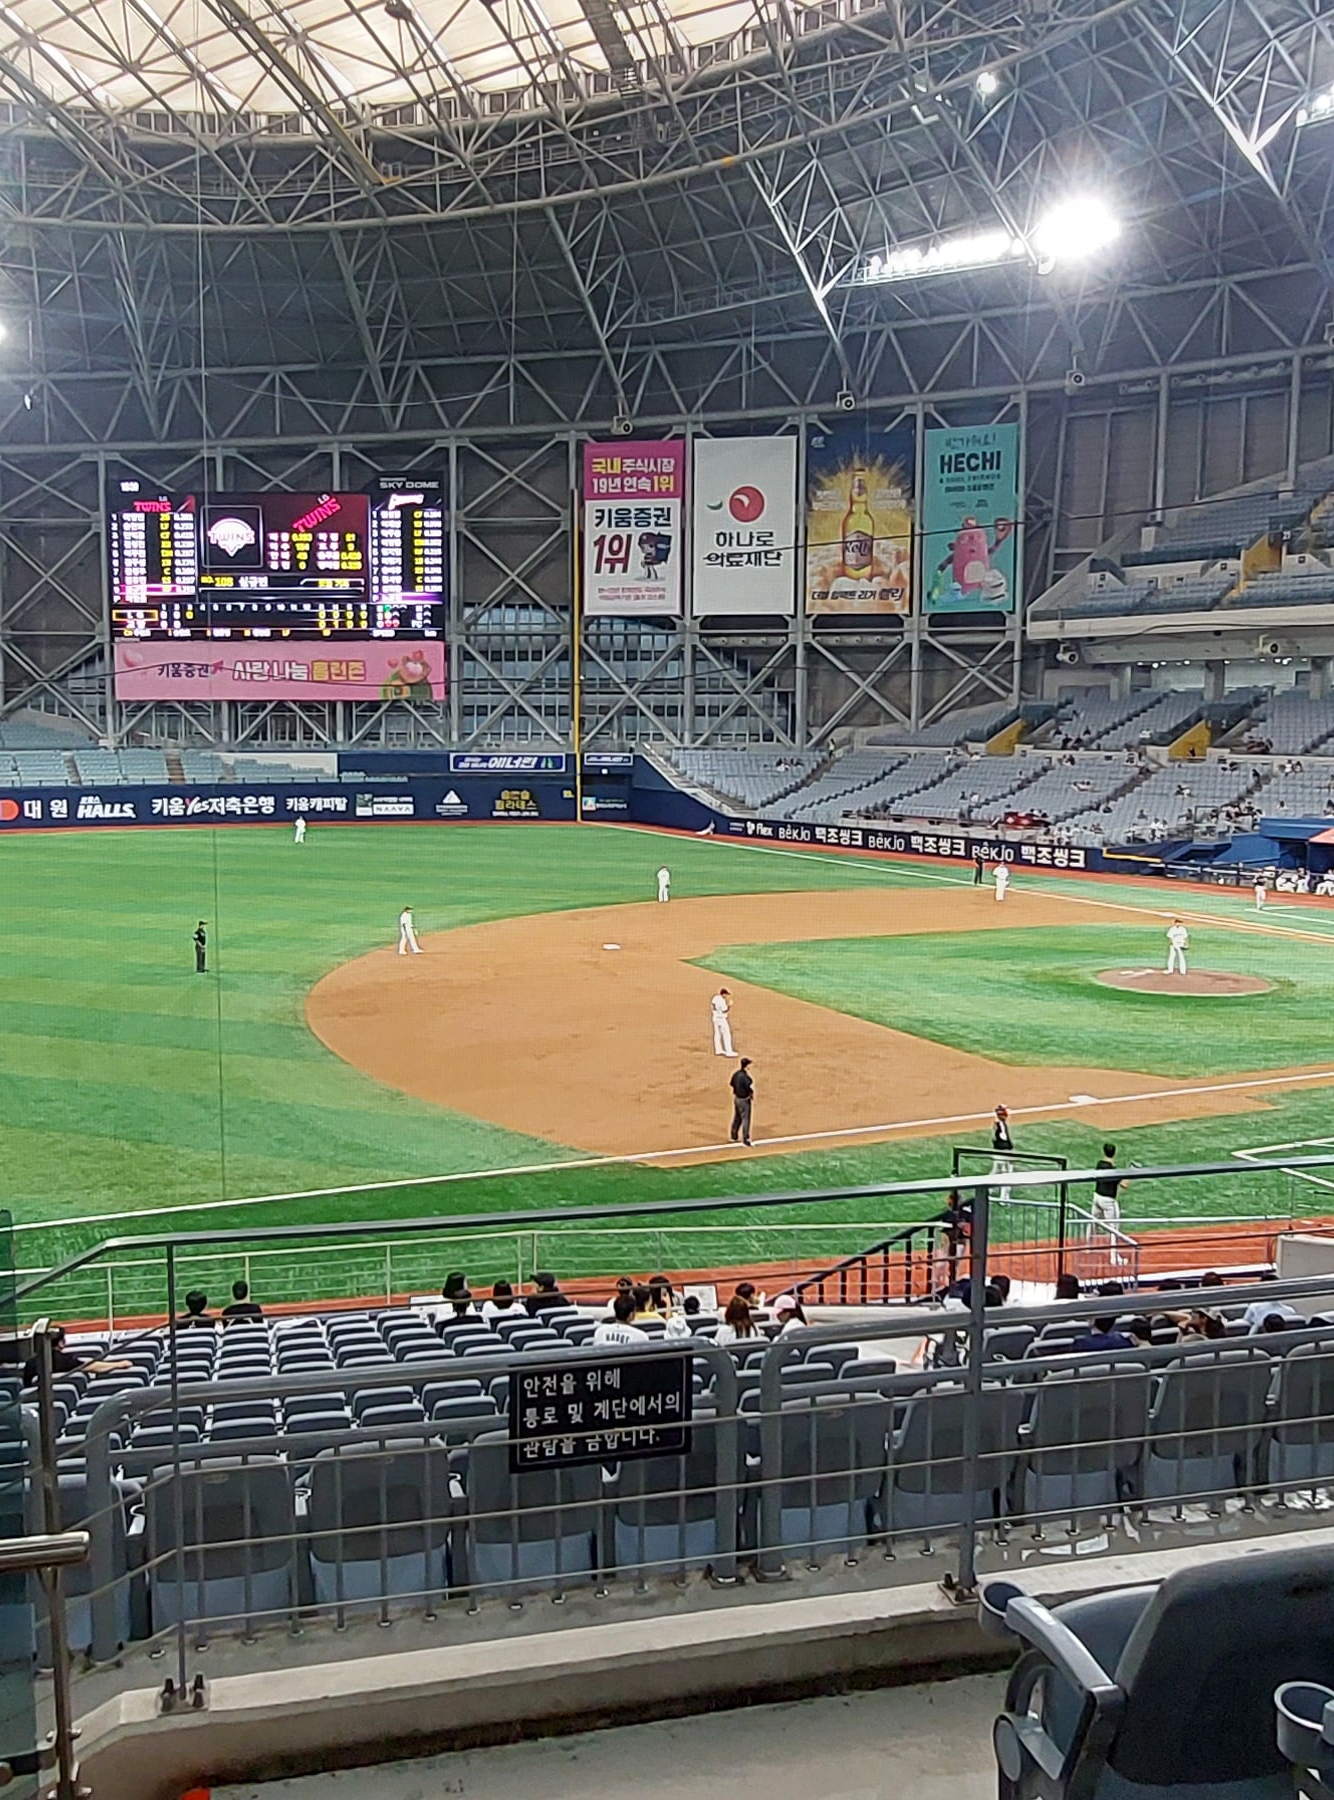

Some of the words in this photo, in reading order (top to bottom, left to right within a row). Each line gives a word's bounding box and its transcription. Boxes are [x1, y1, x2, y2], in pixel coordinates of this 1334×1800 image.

[592, 458, 621, 473] 국내
[622, 458, 674, 473] 주식시장
[940, 451, 1001, 474] HECHI
[593, 478, 621, 493] 19년
[623, 477, 651, 492] 연속
[653, 475, 673, 492] 1위
[133, 502, 171, 512] TWINS
[292, 498, 341, 533] TWINS
[595, 507, 671, 528] 키움증권
[209, 531, 255, 542] TWINS
[716, 531, 774, 547] 하나로
[593, 534, 632, 574] 1위
[704, 551, 782, 567] 의료재단
[158, 664, 211, 678] 키움증권
[233, 661, 270, 681] 사랑
[272, 661, 309, 681] 나눔
[77, 804, 135, 818] HALLS
[286, 797, 347, 812] 키움캐피탈
[816, 827, 863, 846] 백조씽크
[911, 835, 966, 856] 백조씽크
[1021, 845, 1085, 868] 백조씽크
[523, 1373, 577, 1398] 안전을
[586, 1368, 621, 1392] 위해
[522, 1406, 559, 1429] 통로
[568, 1402, 584, 1424] 및
[593, 1391, 680, 1420] 계단에서의
